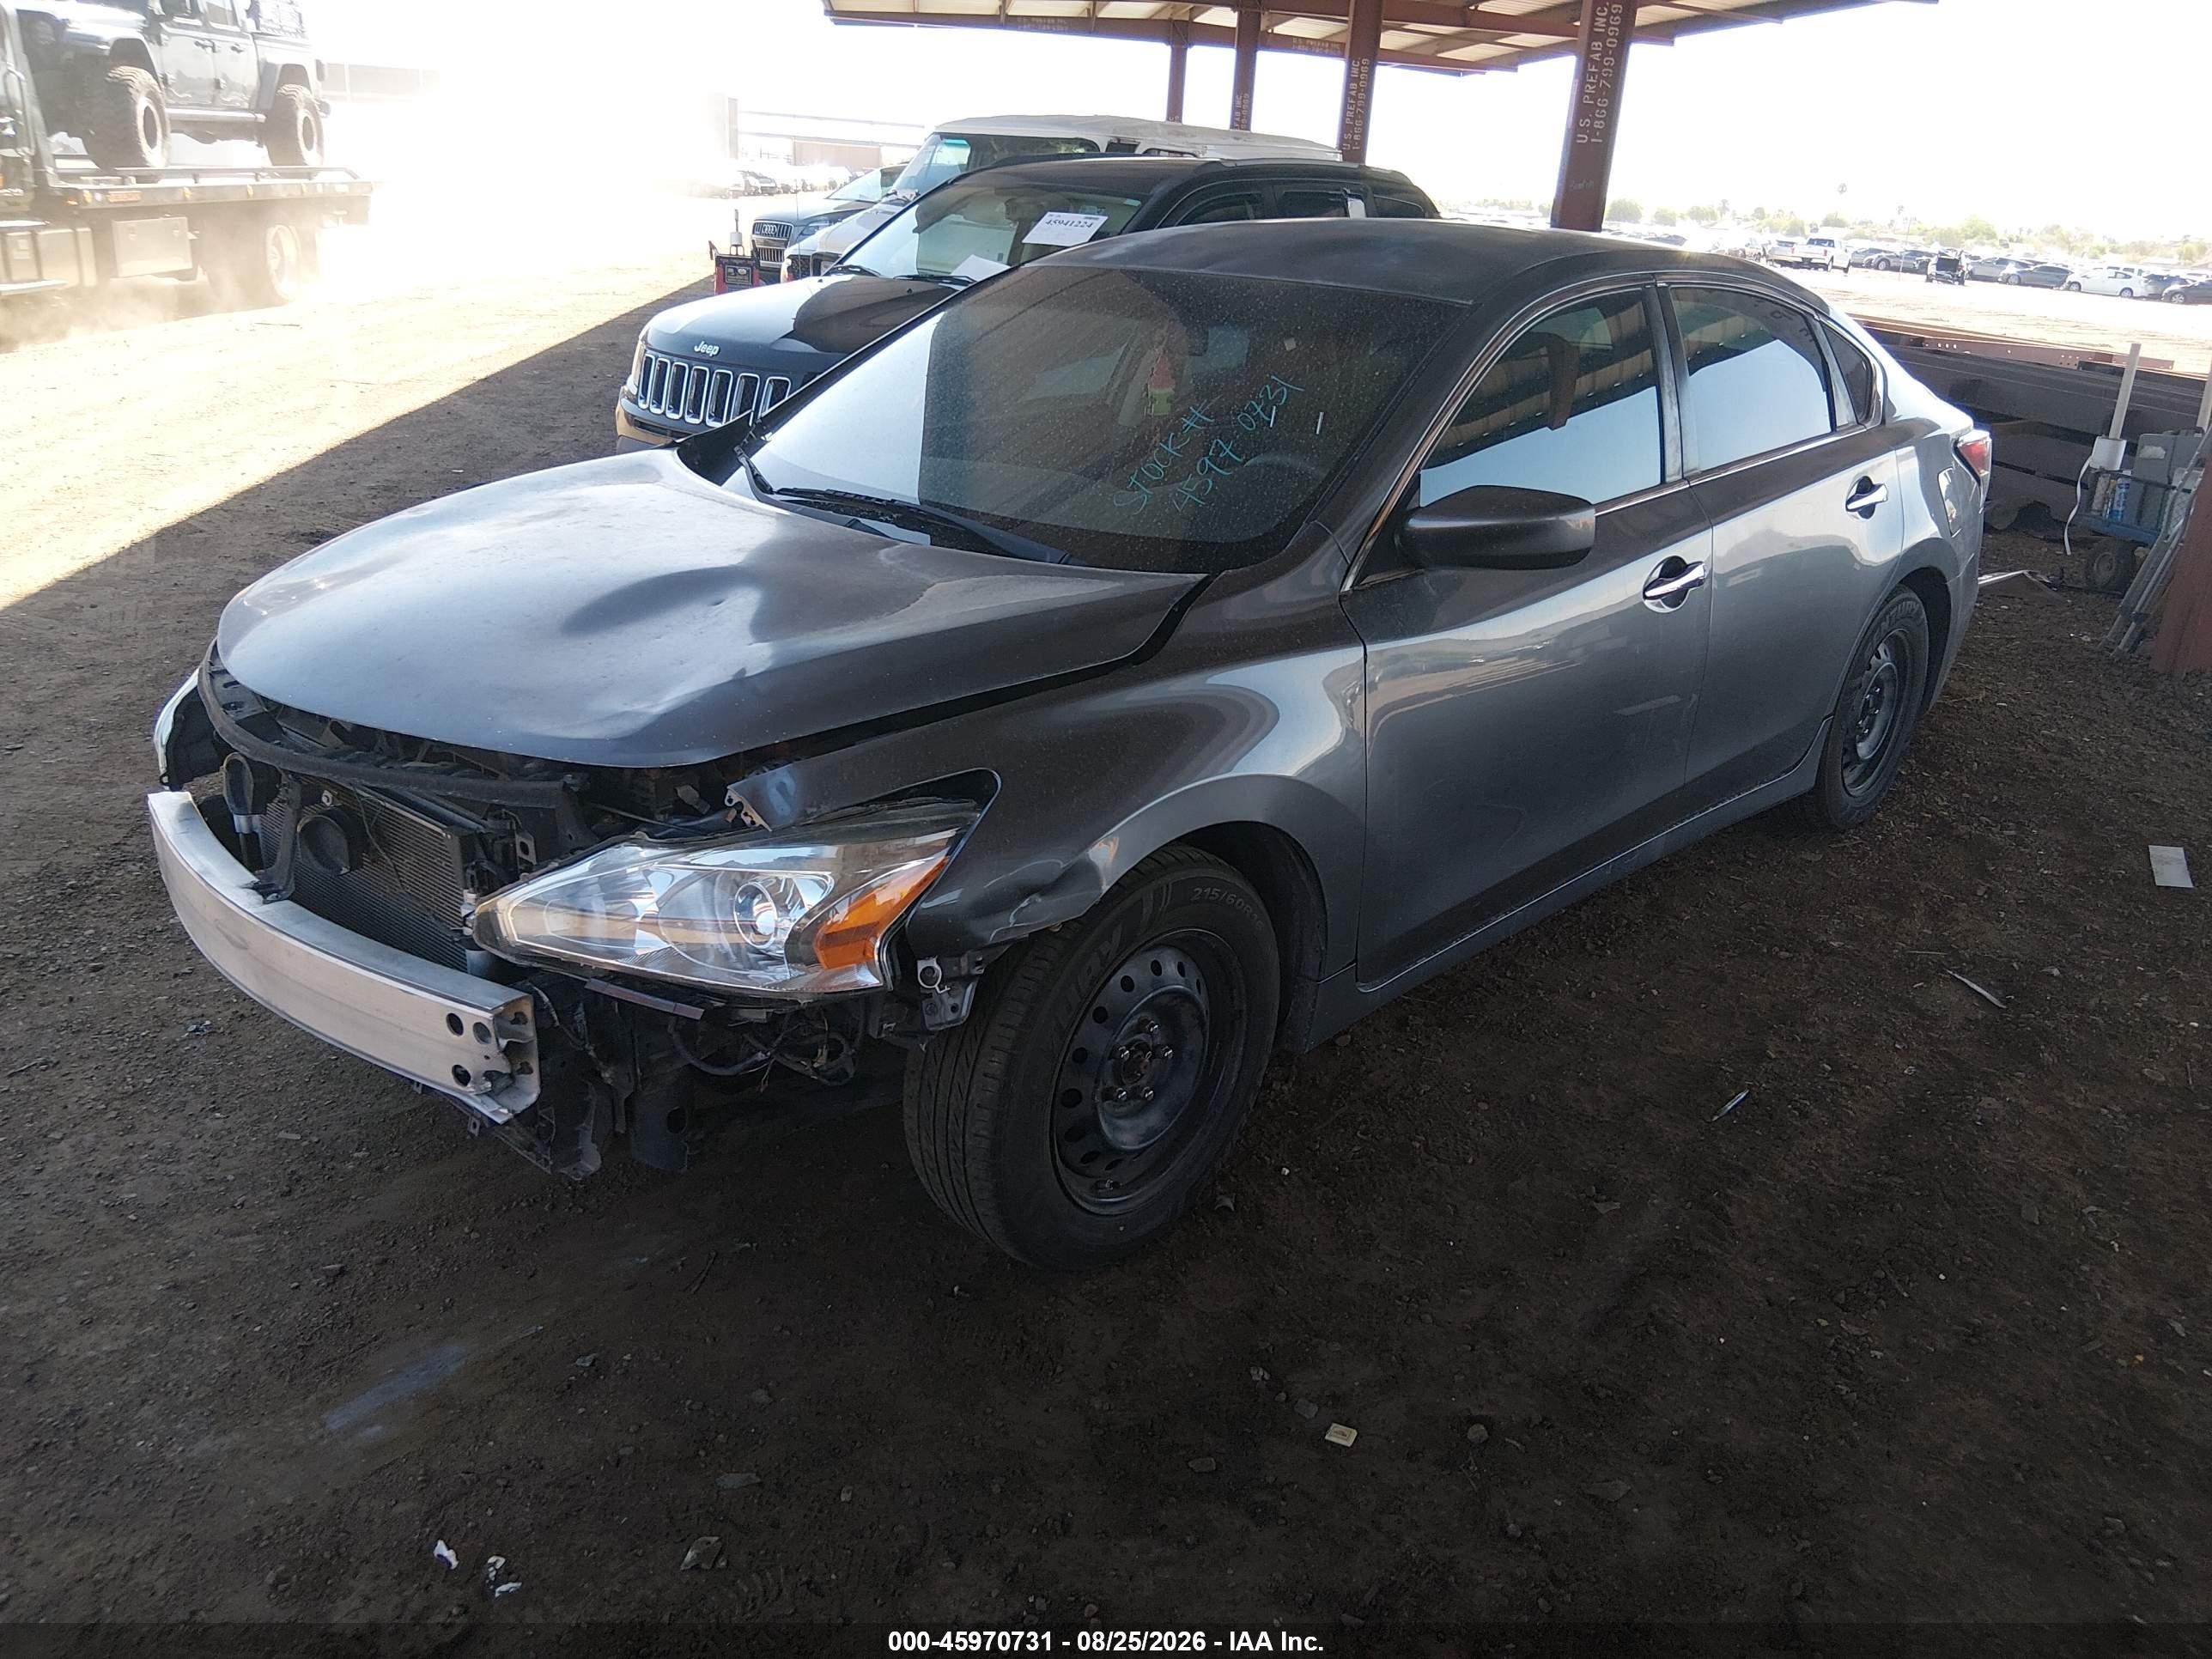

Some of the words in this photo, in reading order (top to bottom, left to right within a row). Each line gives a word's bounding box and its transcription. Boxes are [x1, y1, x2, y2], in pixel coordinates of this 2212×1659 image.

[1594, 1, 1610, 33] INC.
[1583, 41, 1603, 104] PREFAB
[1590, 3, 1624, 143] 1-866-799-0969
[1346, 82, 1358, 125] PREFAB
[1577, 112, 1593, 143] U.S.
[694, 340, 720, 357] Jeep
